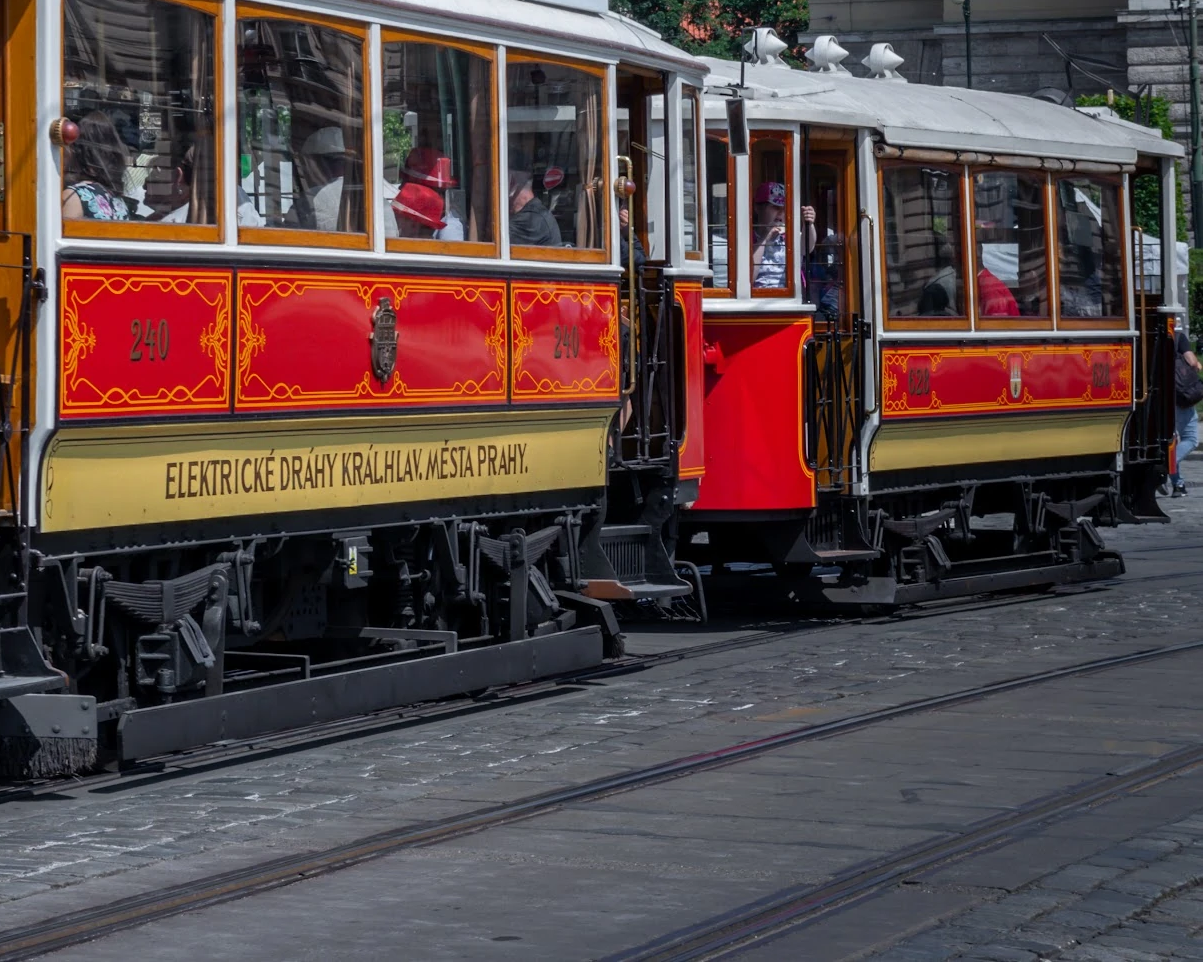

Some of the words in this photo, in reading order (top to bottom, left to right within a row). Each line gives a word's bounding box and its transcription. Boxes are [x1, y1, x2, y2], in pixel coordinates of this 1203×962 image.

[130, 318, 170, 361] 240
[554, 325, 579, 359] 240
[165, 448, 275, 500] ELEKTRICKÉ
[280, 447, 338, 491] DRÁHY
[425, 439, 474, 480] MĚSTA
[478, 443, 528, 476] PRAHY.
